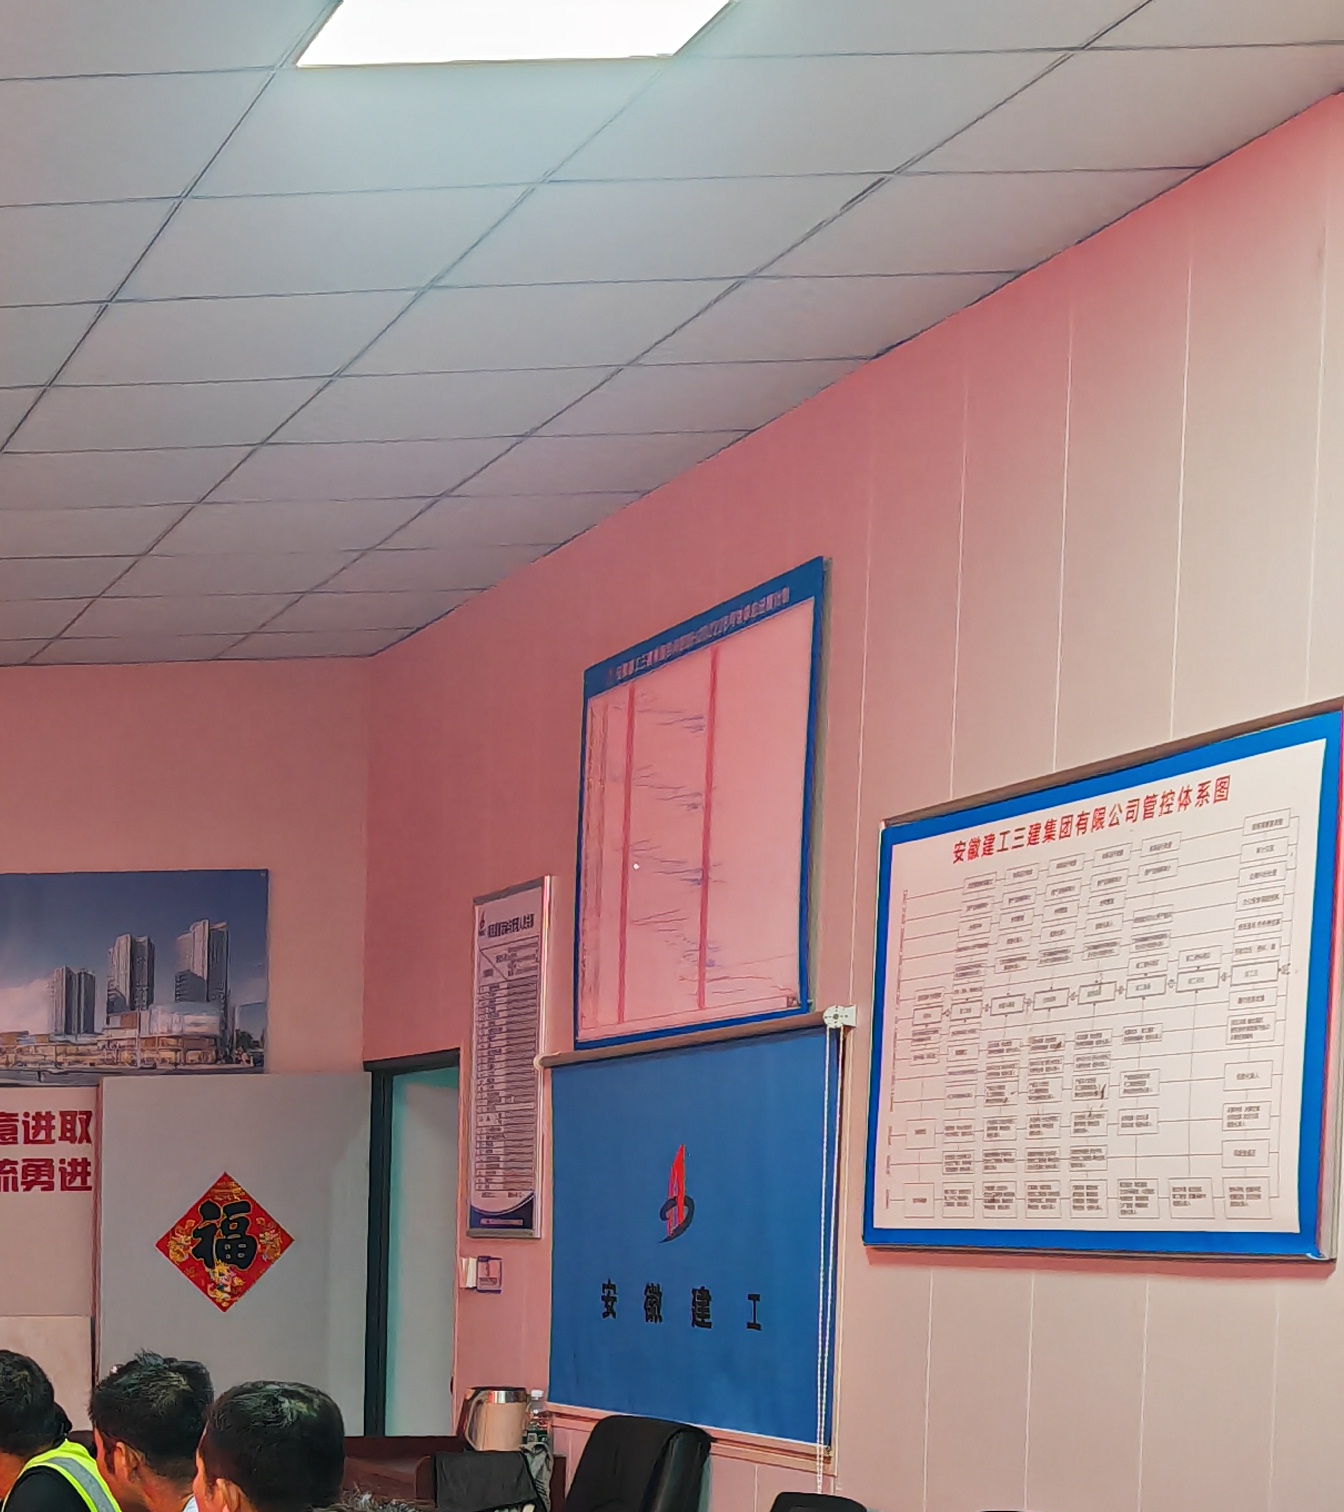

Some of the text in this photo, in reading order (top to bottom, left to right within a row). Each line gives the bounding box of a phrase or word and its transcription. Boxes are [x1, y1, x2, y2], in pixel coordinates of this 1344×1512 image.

[951, 774, 1231, 865] 安徽建工三建集团有限公司管控体系图
[191, 1200, 259, 1270] 福
[601, 1278, 763, 1332] 安徽建工
